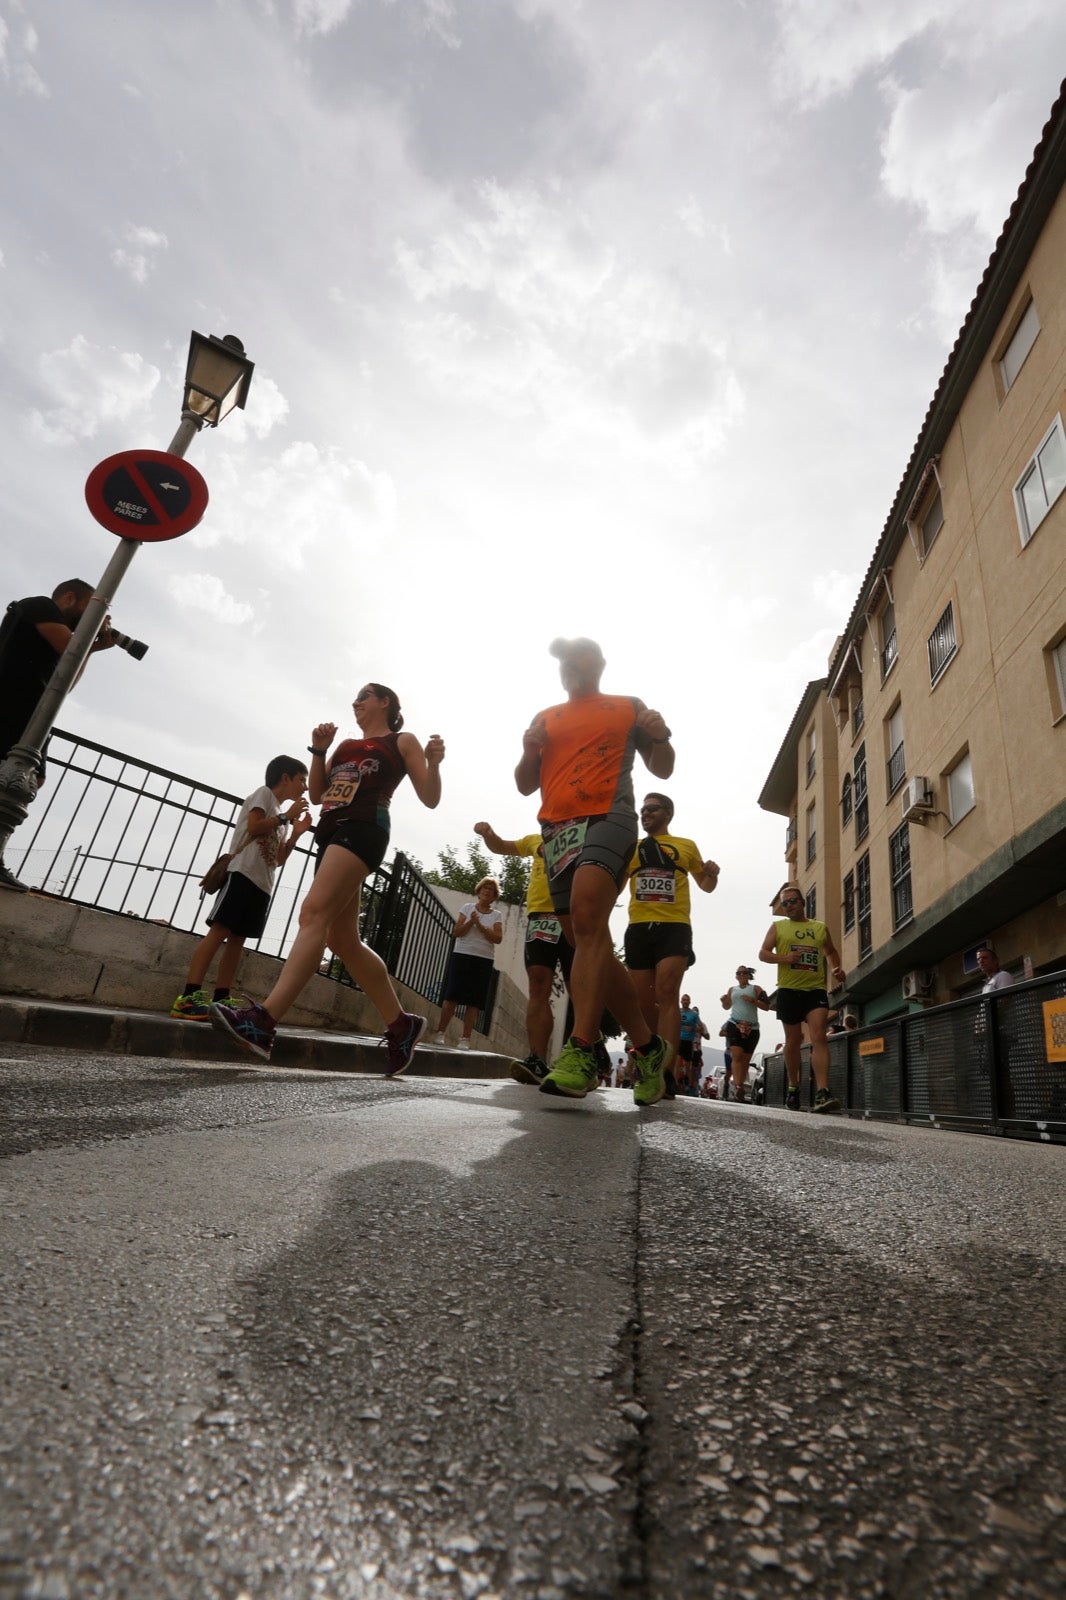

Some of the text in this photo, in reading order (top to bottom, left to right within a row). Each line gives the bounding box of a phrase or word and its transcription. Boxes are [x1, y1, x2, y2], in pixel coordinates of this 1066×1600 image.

[114, 506, 143, 519] PARES
[117, 500, 148, 514] MESES
[326, 783, 353, 798] 250
[553, 827, 579, 856] 452
[640, 878, 672, 891] 3026
[532, 920, 557, 933] 204
